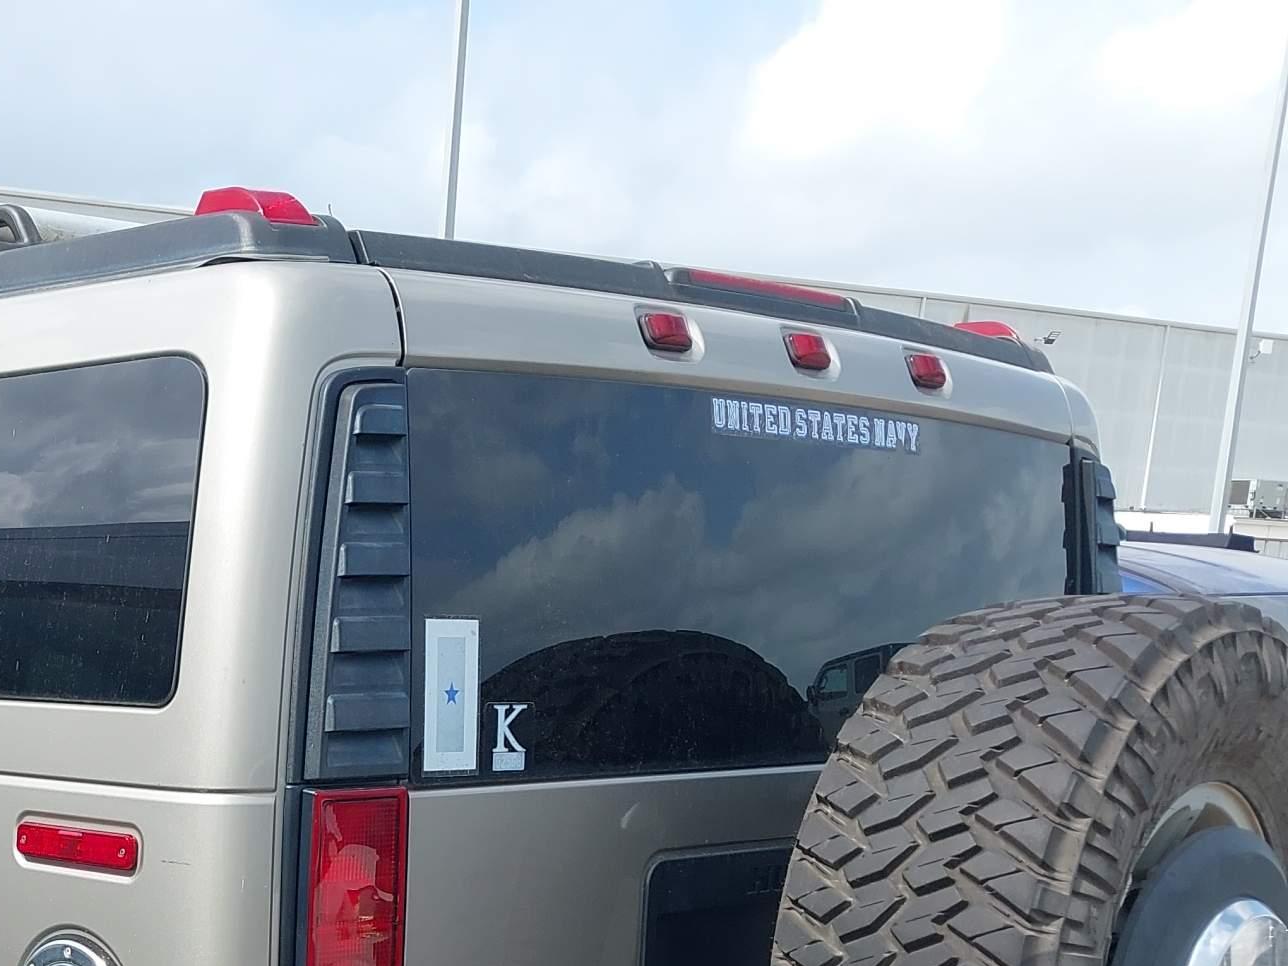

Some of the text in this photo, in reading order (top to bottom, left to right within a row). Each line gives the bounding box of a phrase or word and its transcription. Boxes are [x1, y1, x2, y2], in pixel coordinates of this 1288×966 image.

[712, 398, 920, 452] UNITED STATES NAVY
[492, 704, 528, 752] K
